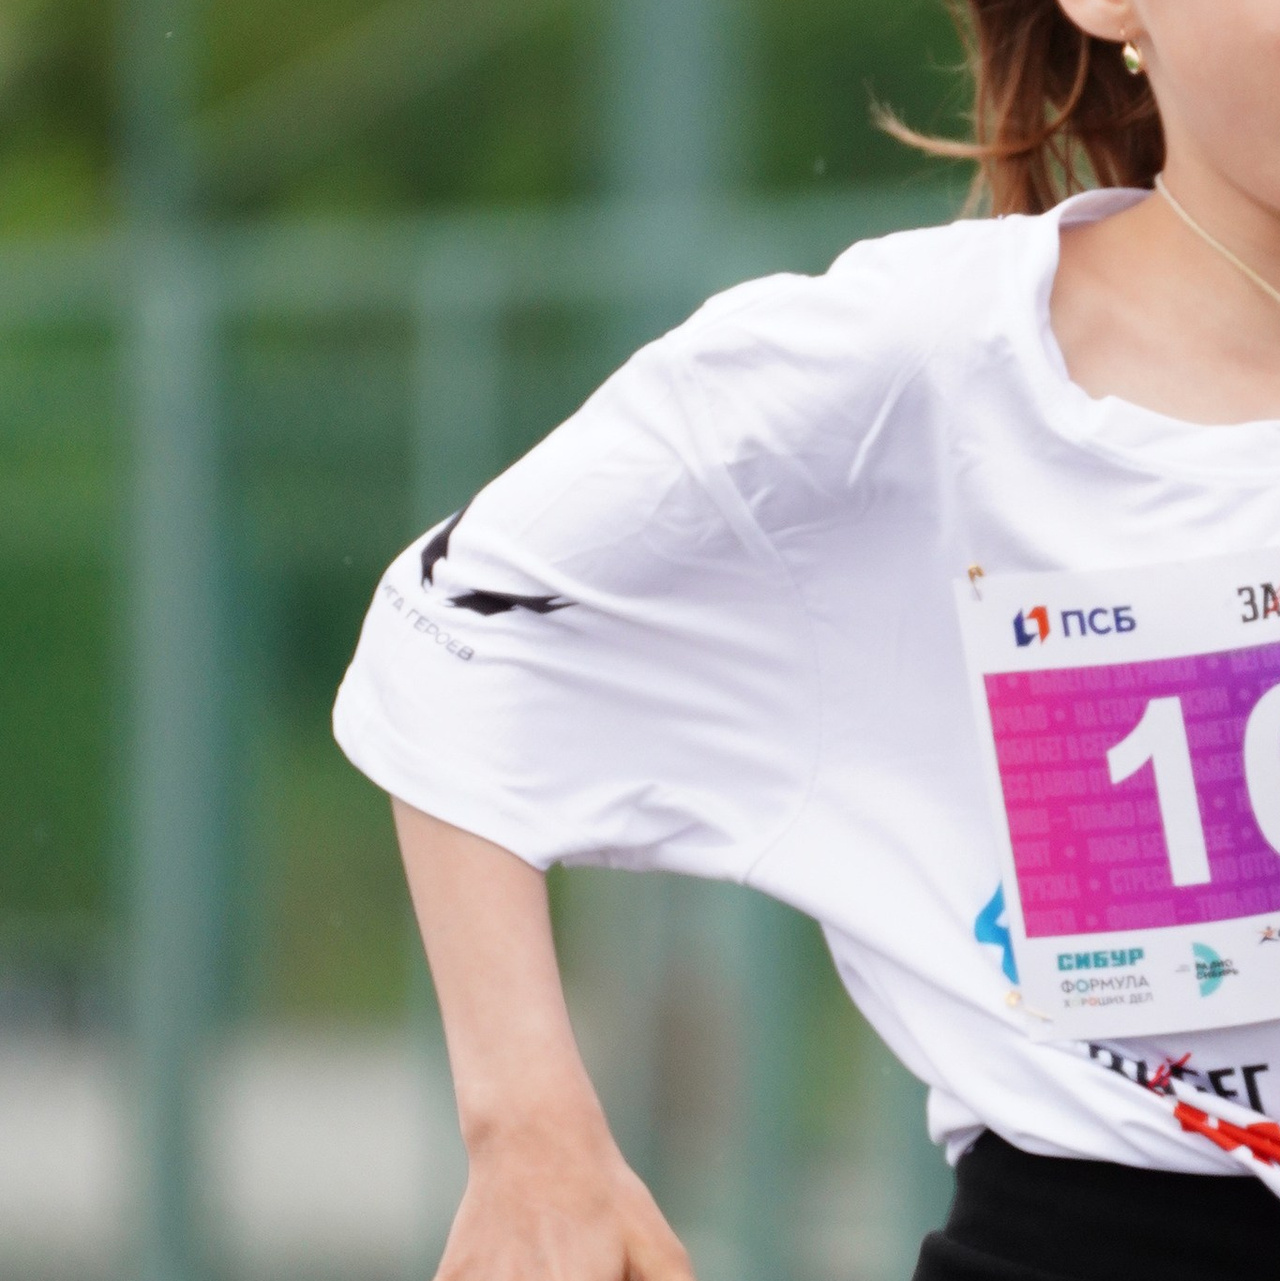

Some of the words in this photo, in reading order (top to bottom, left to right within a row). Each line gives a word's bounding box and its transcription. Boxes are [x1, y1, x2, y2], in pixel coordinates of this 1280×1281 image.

[1060, 605, 1137, 638] ПСБ
[1057, 947, 1145, 972] СИБУР
[1060, 975, 1150, 994] ФОРМУЛА
